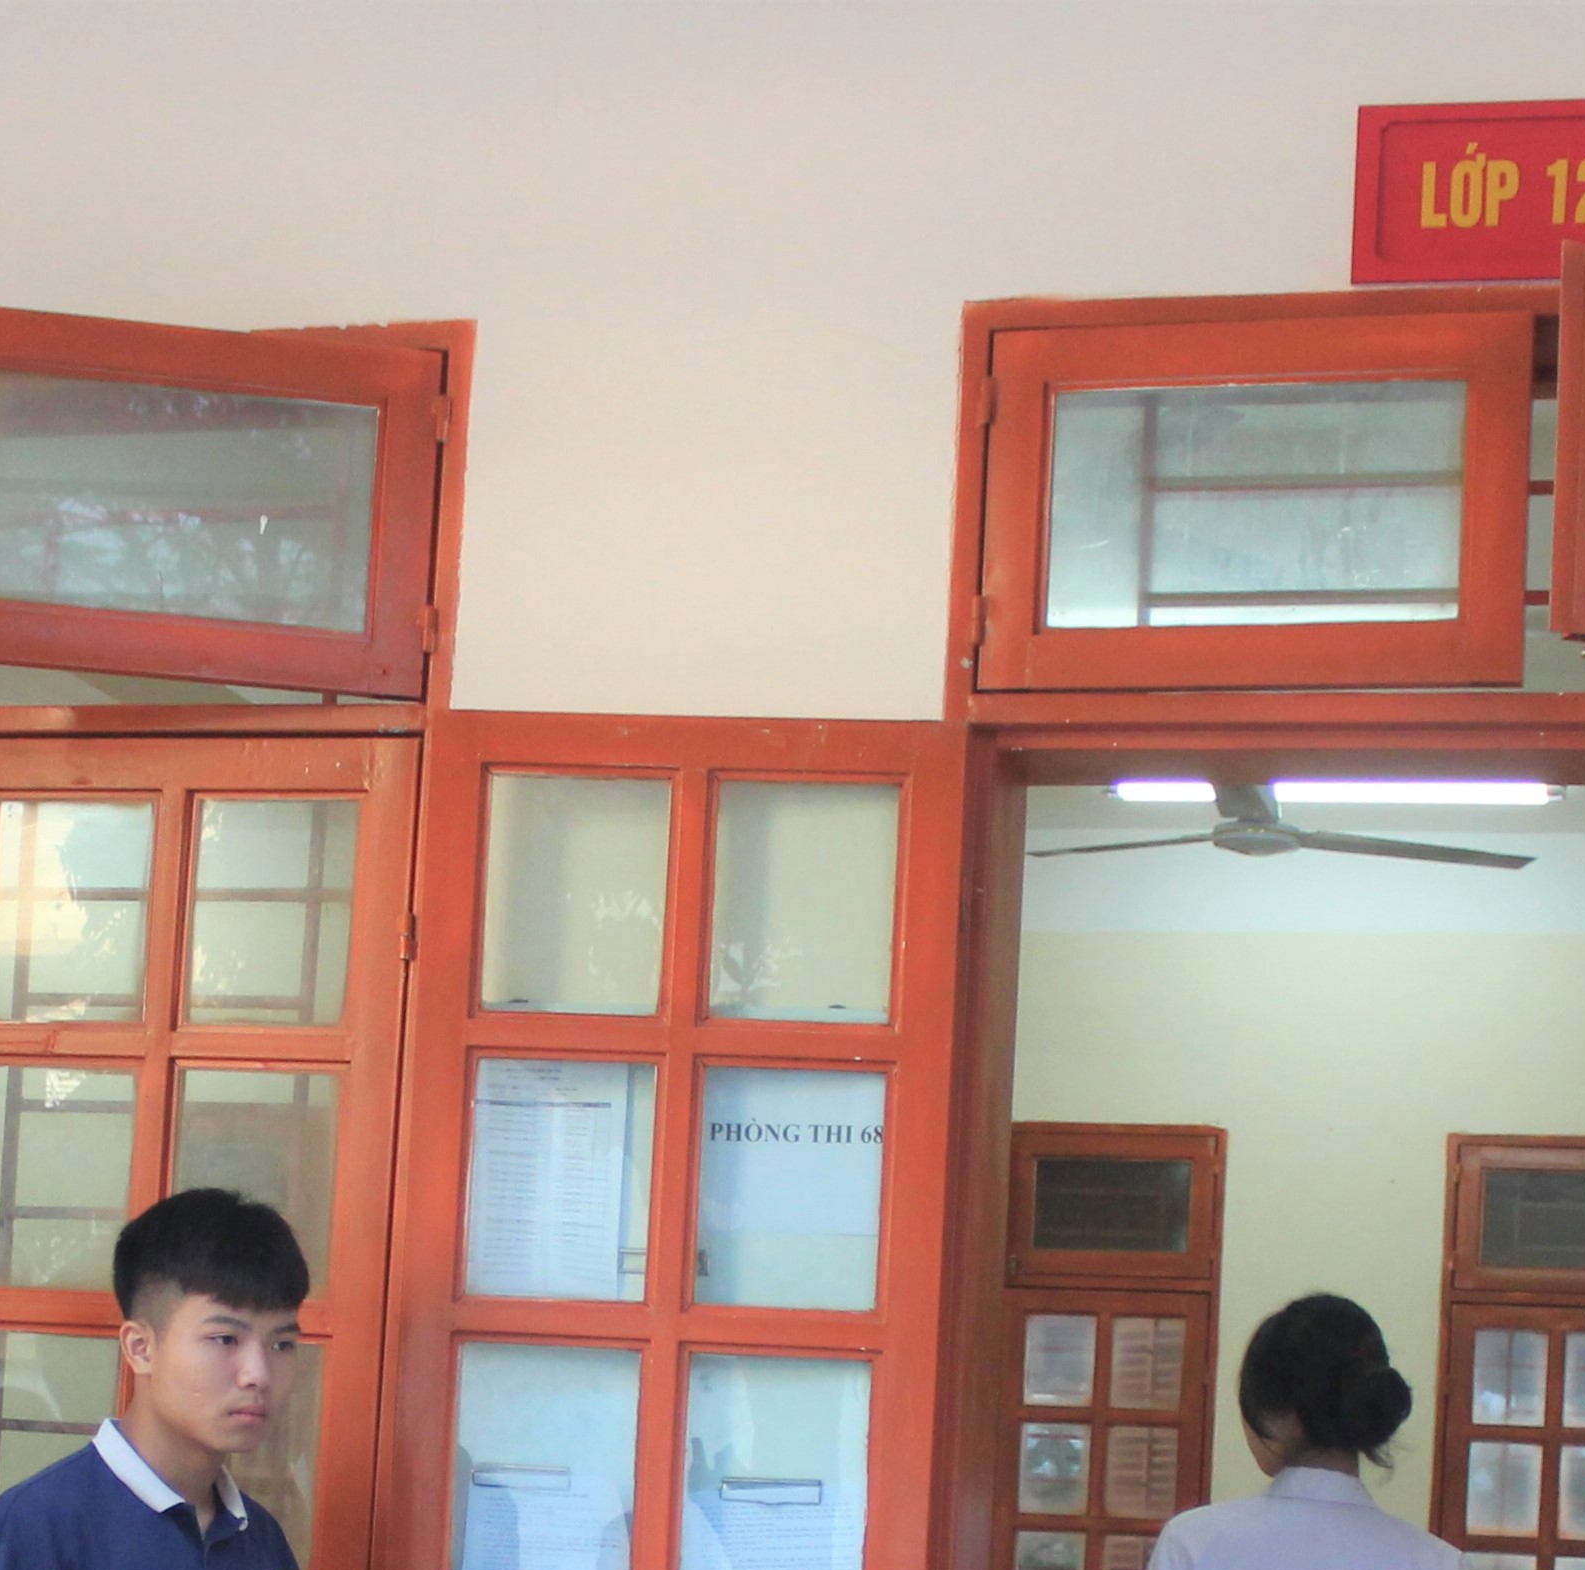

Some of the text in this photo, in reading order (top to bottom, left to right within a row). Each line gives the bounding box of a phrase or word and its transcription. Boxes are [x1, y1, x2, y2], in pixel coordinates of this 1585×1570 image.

[1420, 142, 1520, 229] LỚP
[710, 1118, 884, 1145] PHÒNG THI 68
